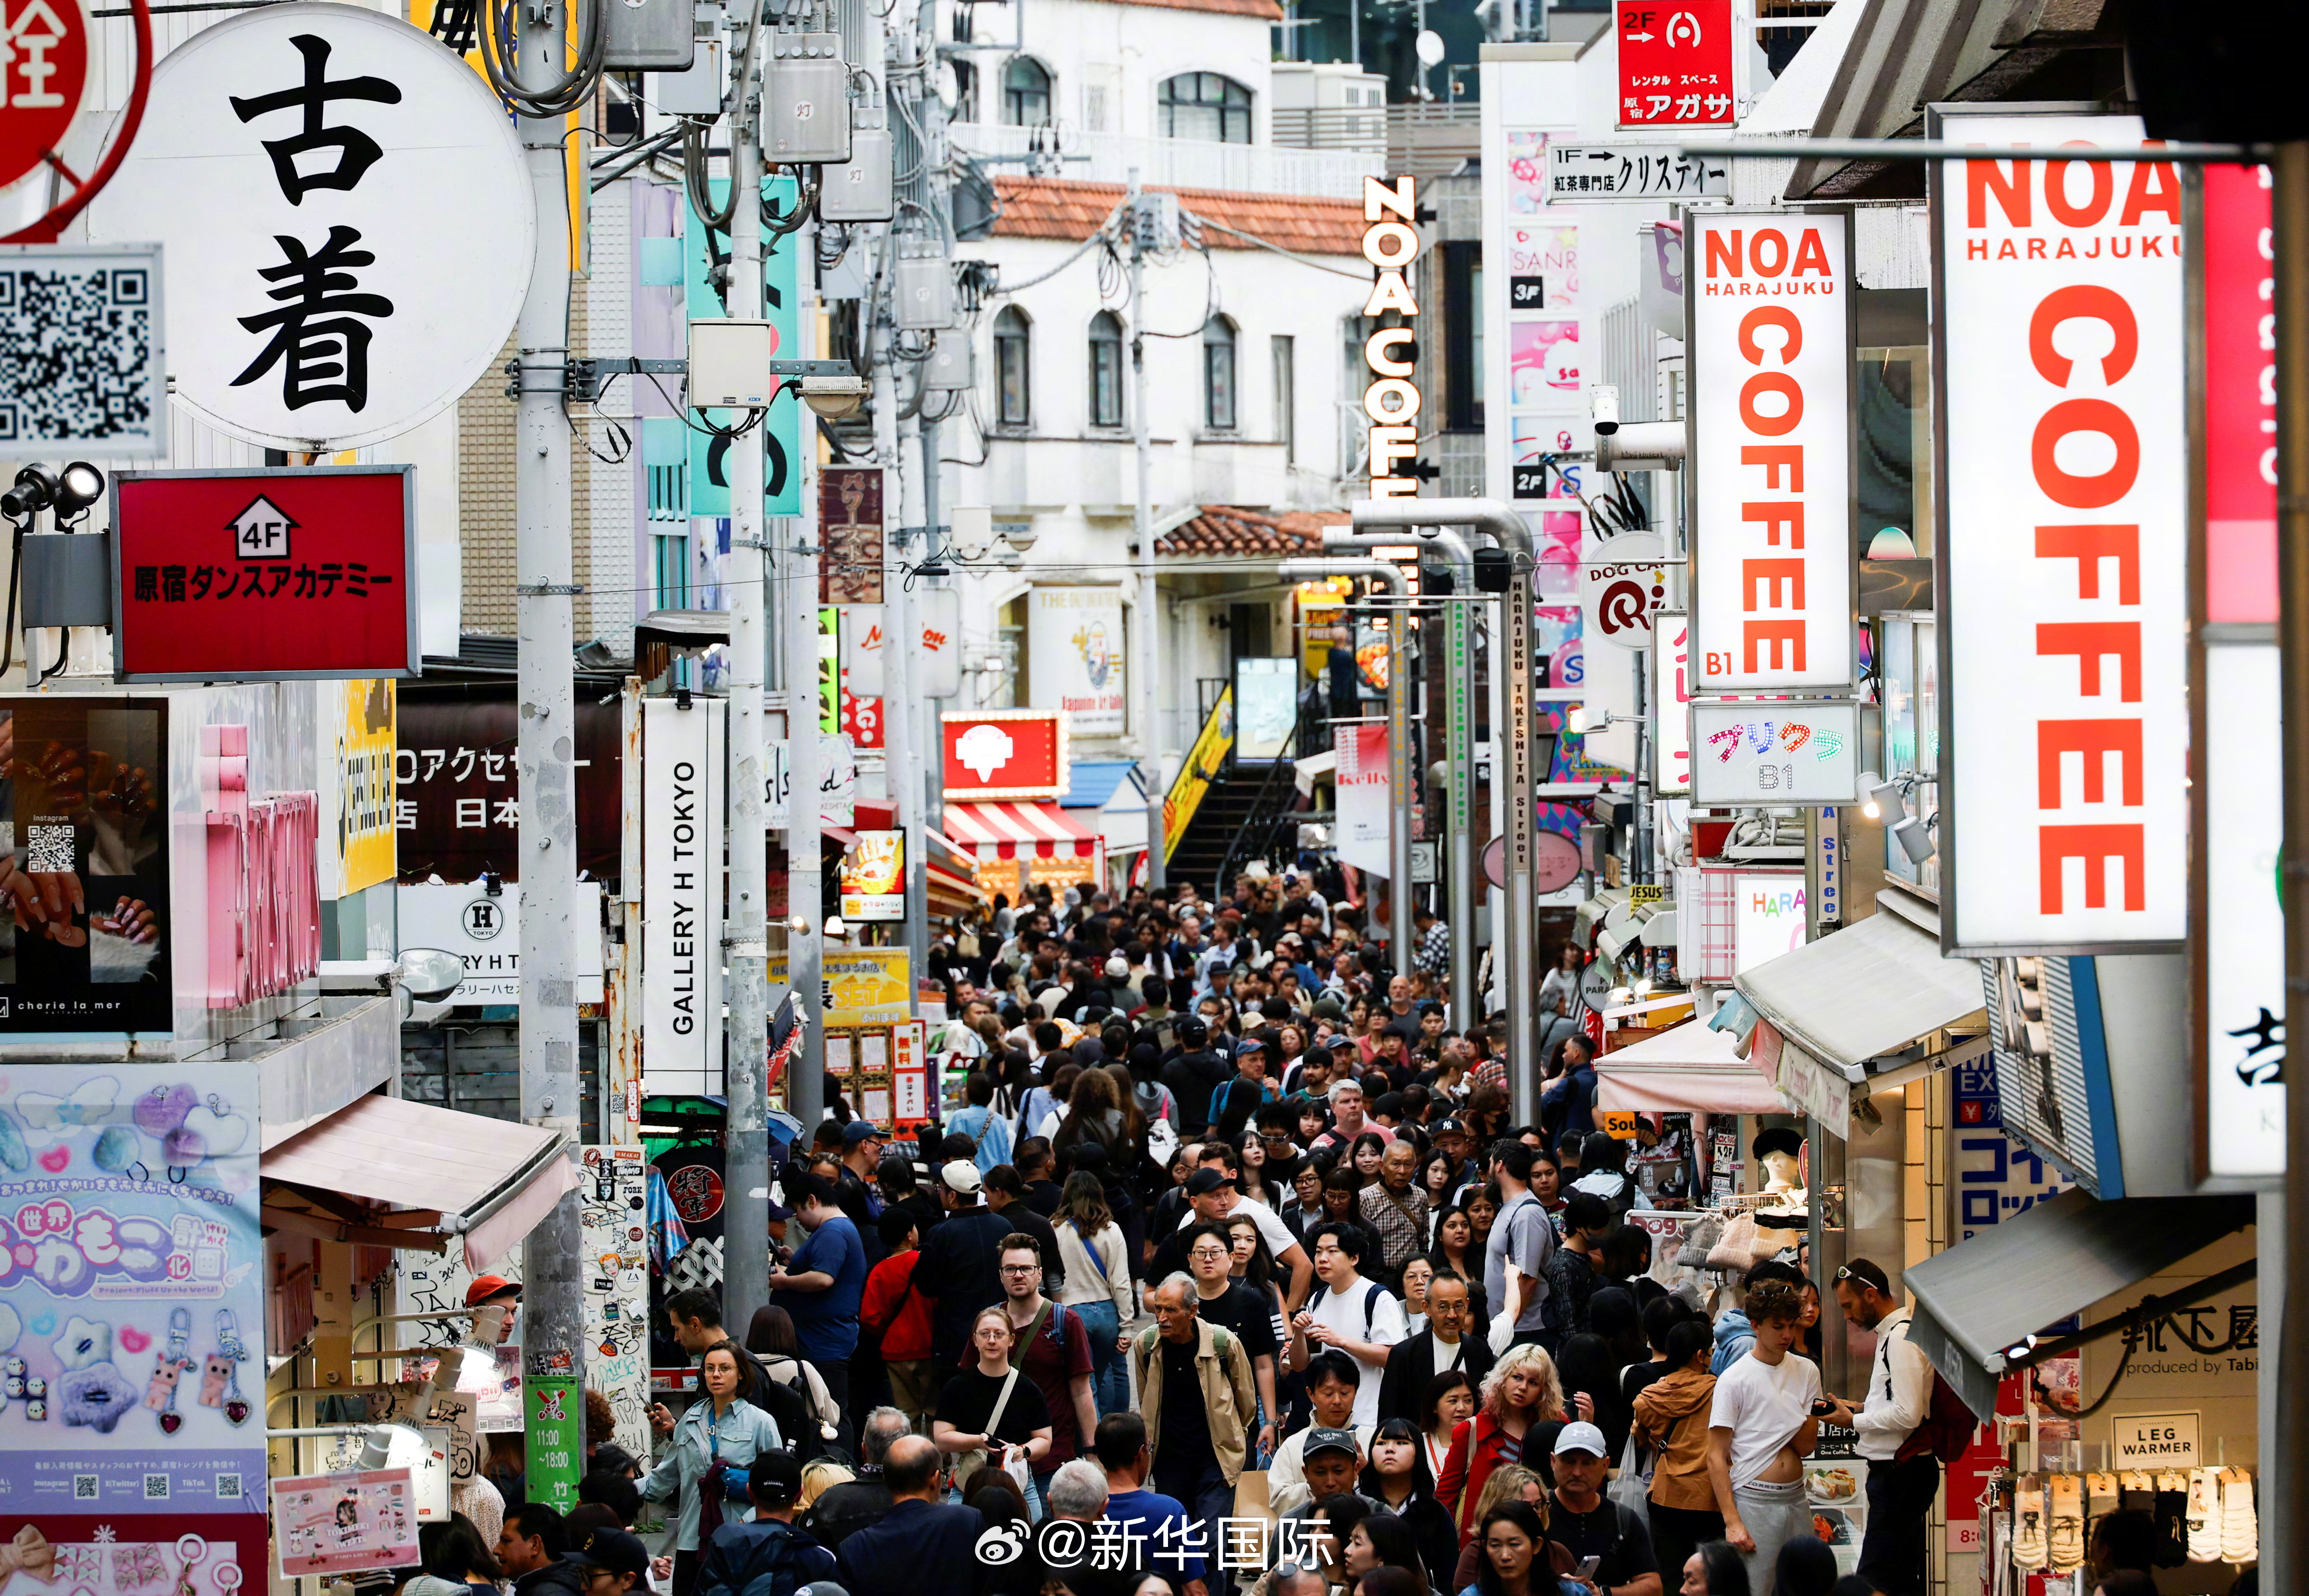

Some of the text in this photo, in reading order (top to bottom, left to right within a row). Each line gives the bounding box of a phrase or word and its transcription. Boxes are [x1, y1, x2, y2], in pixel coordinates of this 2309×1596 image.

[1624, 11, 1656, 29] 2F
[1632, 74, 1718, 86] レンタル スペース
[797, 103, 813, 118] 灯
[1624, 97, 1643, 120] 原宿
[1645, 93, 1731, 120] アガサ
[1557, 150, 1582, 164] 1F
[1554, 175, 1614, 192] 紅茶専門店
[1616, 155, 1726, 194] クリスティー
[228, 33, 406, 414] 古着
[1362, 175, 1419, 316] NOA
[1705, 228, 1832, 278] NOA
[1514, 284, 1540, 300] 3F
[1706, 282, 1834, 296] HARAJUKU
[1517, 473, 1543, 490] 2F
[1737, 305, 1806, 673] COFFEE
[242, 522, 282, 548] 4F
[134, 563, 392, 602] 原宿ダンスアカデミー
[1590, 563, 1628, 581] DOG
[2029, 285, 2145, 915] COFFEE
[1706, 652, 1732, 676] B1
[1513, 581, 1526, 864] HARAJUKU TAKESHITA Street
[1708, 721, 1843, 763] プリクラ
[1759, 764, 1793, 789] B1
[348, 750, 390, 834] CAPSULE LAB
[1823, 837, 1836, 921] Stree
[673, 761, 695, 1035] GALLERY H TOKYO
[1630, 886, 1662, 898] JESUS
[18, 1000, 120, 1011] cherie la mer
[836, 983, 880, 1007] SET
[912, 1026, 919, 1043] 本日
[898, 1036, 911, 1064] 無料
[1682, 1128, 1691, 1157] 日本人形
[22, 1206, 68, 1231] 世界
[169, 1258, 189, 1279] 化
[2126, 1358, 2198, 1378] produced
[2203, 1357, 2222, 1375] by
[536, 1429, 559, 1446] 11:00
[2137, 1427, 2176, 1441] LEG
[539, 1451, 569, 1468] ~18:00
[2123, 1442, 2191, 1455] WARMER
[326, 1522, 370, 1536] TOKIMEKI
